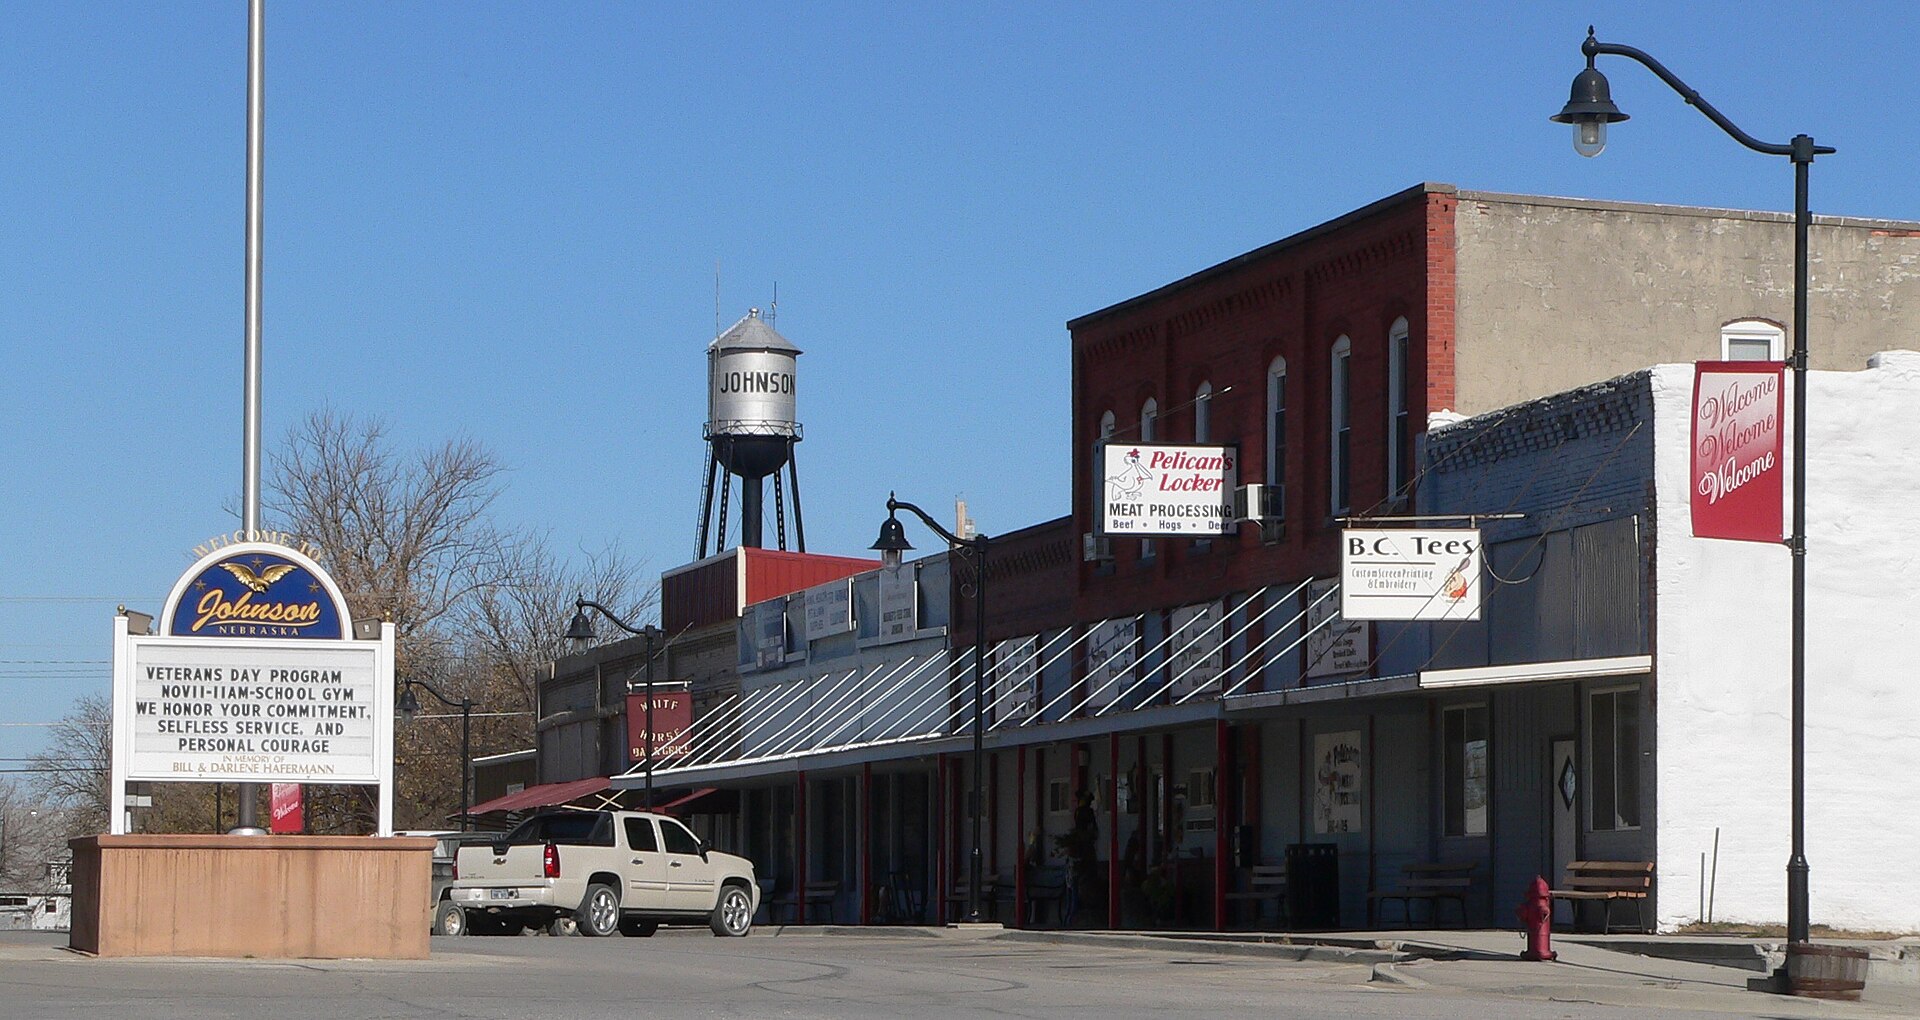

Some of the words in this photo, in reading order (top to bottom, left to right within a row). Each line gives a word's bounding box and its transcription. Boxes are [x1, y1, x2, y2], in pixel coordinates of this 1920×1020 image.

[721, 372, 795, 396] JOHNSON
[1700, 376, 1776, 430] Welcome
[1699, 413, 1775, 466] Welcome
[1150, 450, 1233, 471] Pelican's
[1159, 473, 1225, 492] Locker
[1698, 451, 1775, 505] Welcome
[1110, 503, 1144, 517] MEAT
[1149, 504, 1232, 518] PROCESSING
[1113, 519, 1134, 529] Beef
[1159, 520, 1182, 531] Hogs
[1208, 521, 1229, 530] Deer
[192, 530, 291, 560] WELCOME
[299, 541, 321, 560] TO
[1349, 537, 1399, 556] B.C.
[1410, 536, 1475, 555] Tees
[191, 589, 321, 632] Johnson
[219, 626, 299, 636] NEBRASKA
[147, 667, 222, 680] VETERANS
[231, 669, 260, 682] DAY
[270, 670, 342, 683] PROGRAM
[323, 688, 354, 701] GYM
[136, 702, 156, 715] WE
[163, 703, 213, 716] HONOR
[221, 704, 261, 717] YOUR
[267, 704, 371, 719] COMMITMENT,
[158, 720, 229, 734] SELFLESS
[315, 722, 344, 736] AND
[179, 738, 255, 752] PERSONAL
[261, 739, 329, 753] COURAGE
[223, 755, 232, 763] IN
[235, 755, 270, 763] MEMORY
[173, 762, 193, 772] BILL
[198, 763, 207, 773] &
[211, 763, 259, 773] DARLENE
[264, 763, 335, 774] HAFERMANN
